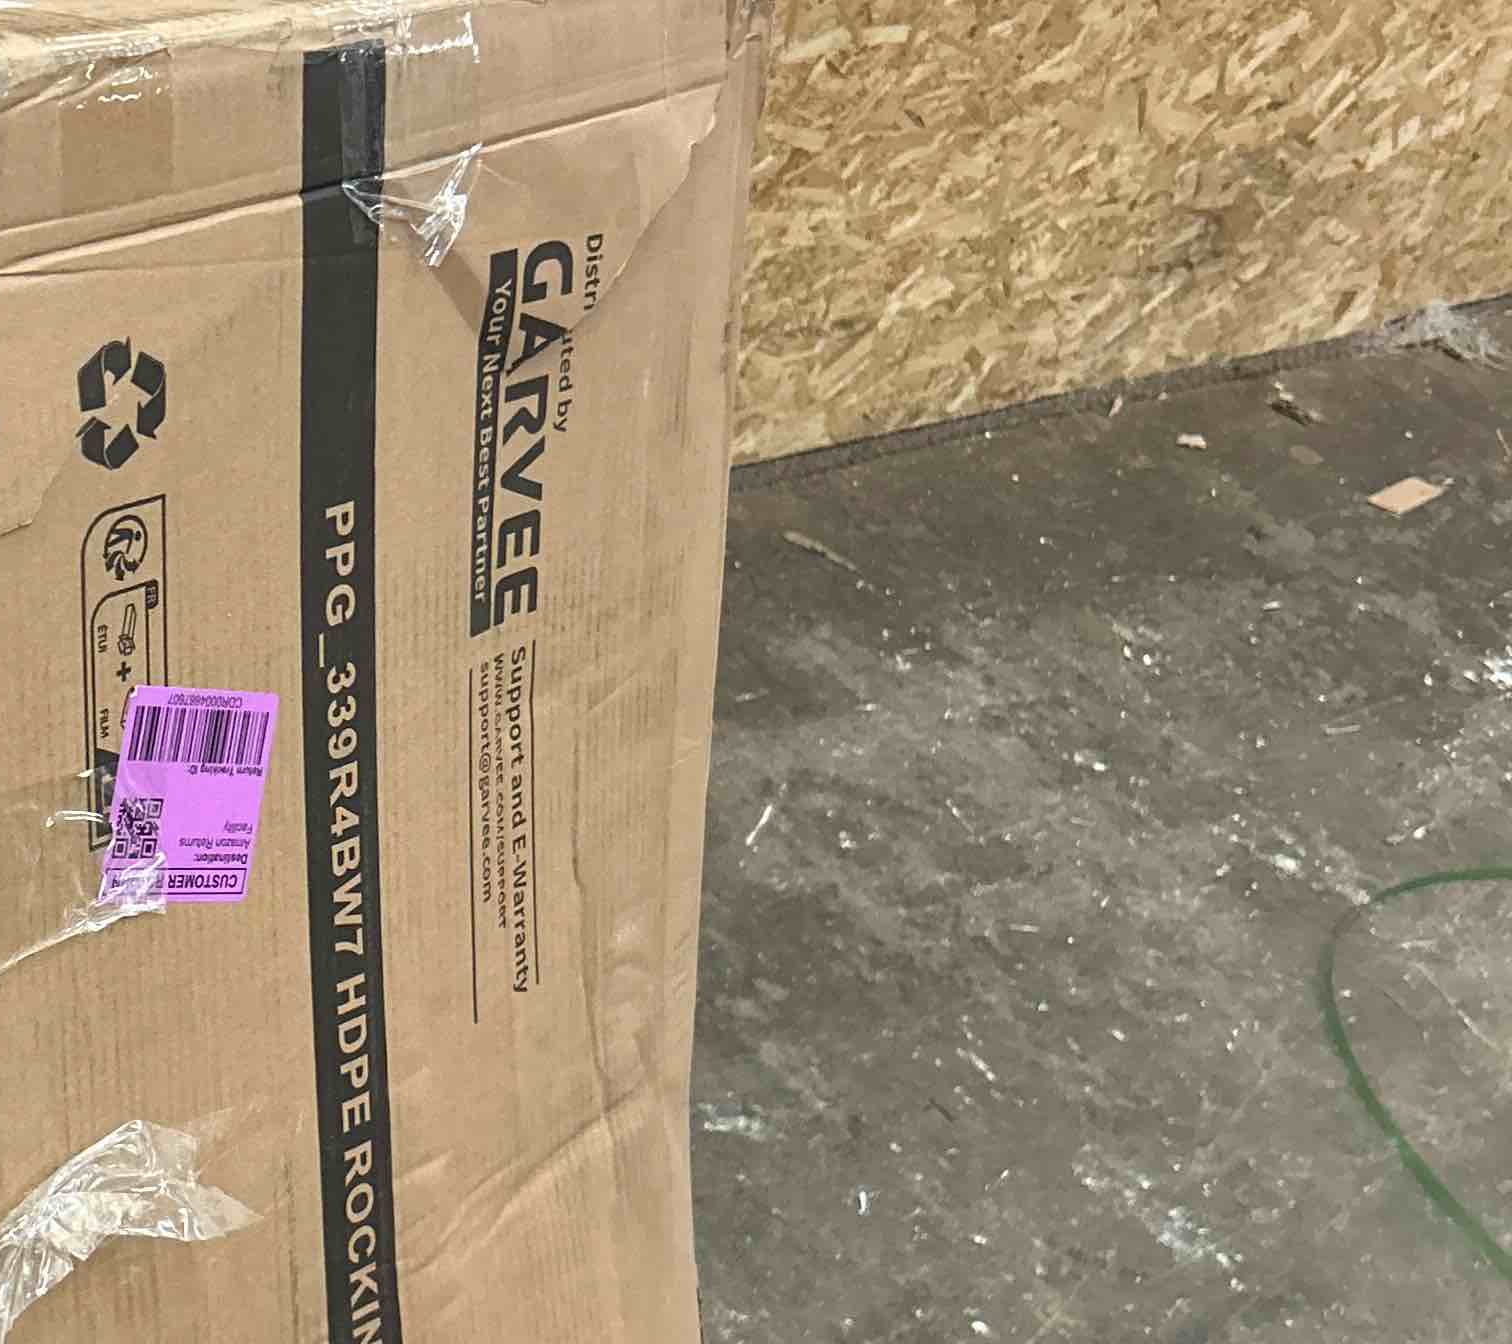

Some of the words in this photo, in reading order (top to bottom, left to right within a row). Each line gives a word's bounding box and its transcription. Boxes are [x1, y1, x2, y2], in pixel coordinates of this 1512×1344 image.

[482, 278, 513, 346] Your
[556, 232, 604, 393] Distriuted
[479, 352, 501, 419] Next
[552, 399, 573, 433] by
[476, 427, 494, 489] Best
[492, 240, 575, 628] GARVEE
[473, 496, 492, 603] Partner
[97, 707, 110, 739] FILM
[318, 499, 367, 962] PPG_339R4BW7
[505, 646, 527, 769] Support
[199, 762, 234, 777] Tracking
[236, 765, 263, 777] Return
[476, 661, 494, 903] support@garvee.com
[223, 820, 254, 835] Facility
[510, 774, 527, 829] and
[178, 837, 214, 850] Returns
[193, 852, 249, 865] Destination:
[215, 838, 252, 850] Amazon
[167, 873, 239, 890] CUSTOMER
[510, 834, 530, 993] E-Warranty
[335, 972, 372, 1136] HDPE
